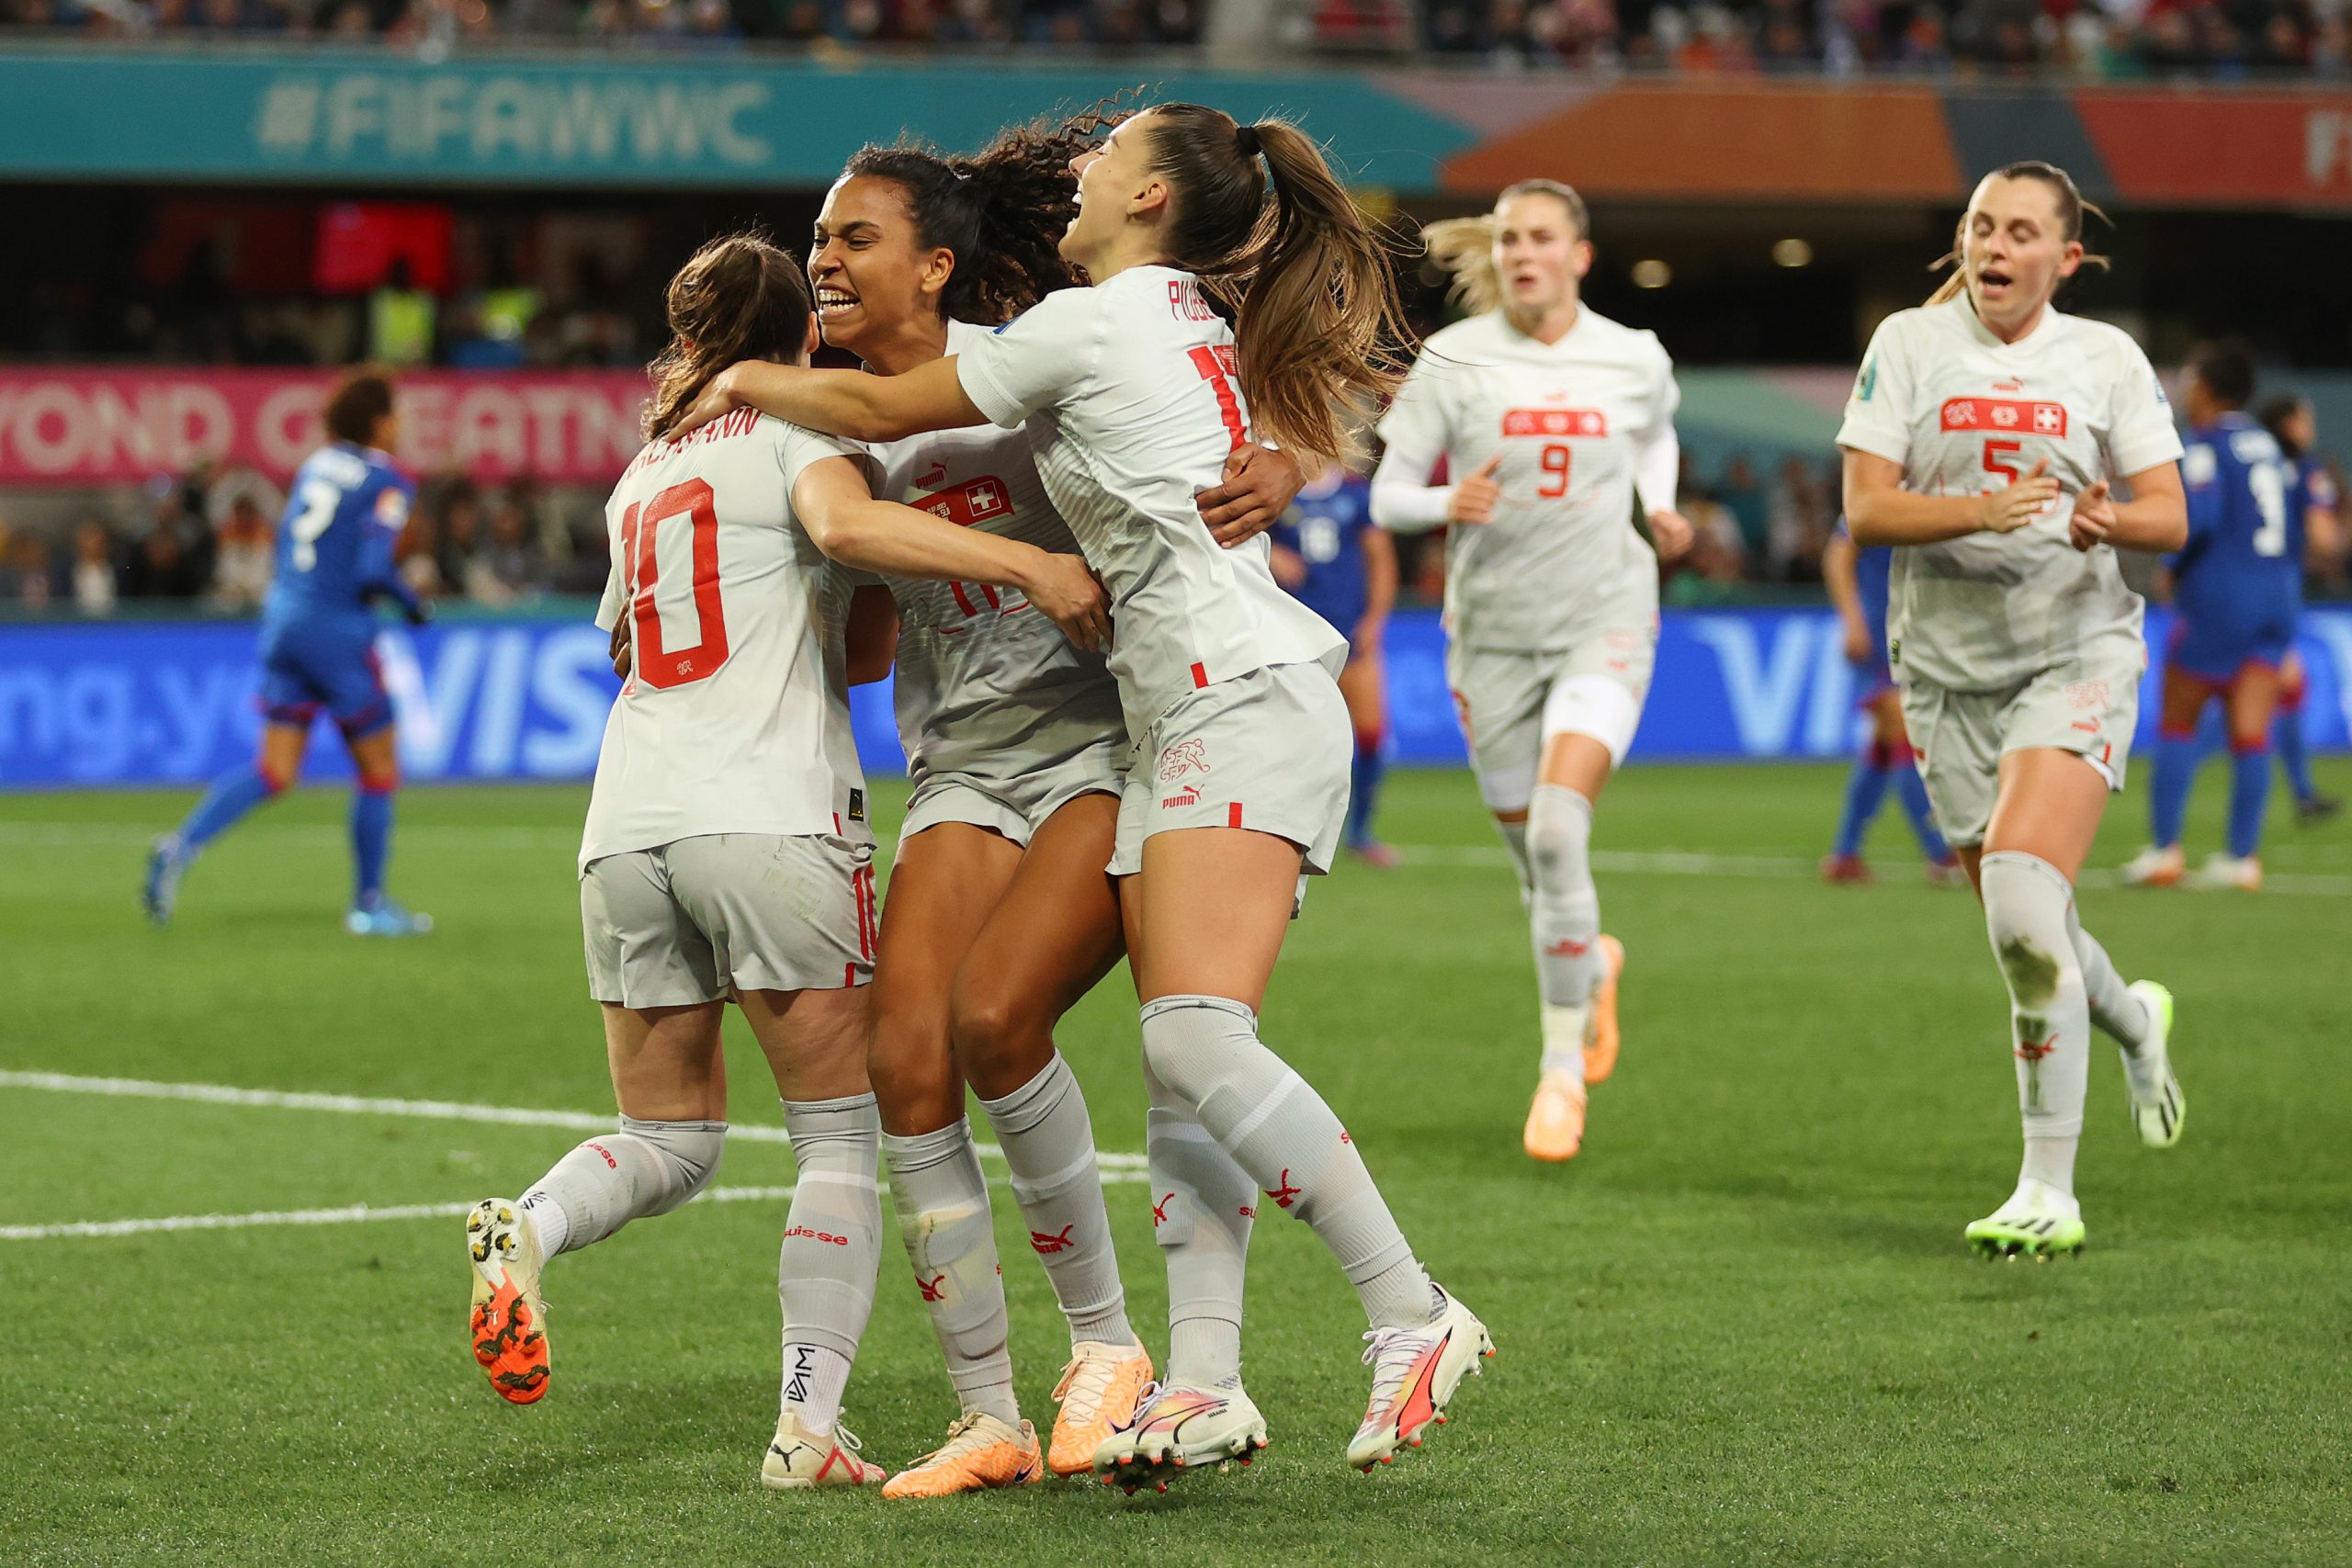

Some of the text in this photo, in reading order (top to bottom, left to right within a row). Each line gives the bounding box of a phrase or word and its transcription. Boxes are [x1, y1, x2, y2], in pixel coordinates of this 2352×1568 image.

[258, 76, 775, 163] #FIFAWWC
[255, 379, 646, 476] GEATN
[1537, 443, 1572, 499] 9
[1981, 438, 2022, 498] 5
[621, 477, 729, 695] 10
[1162, 795, 1195, 809] PUMA
